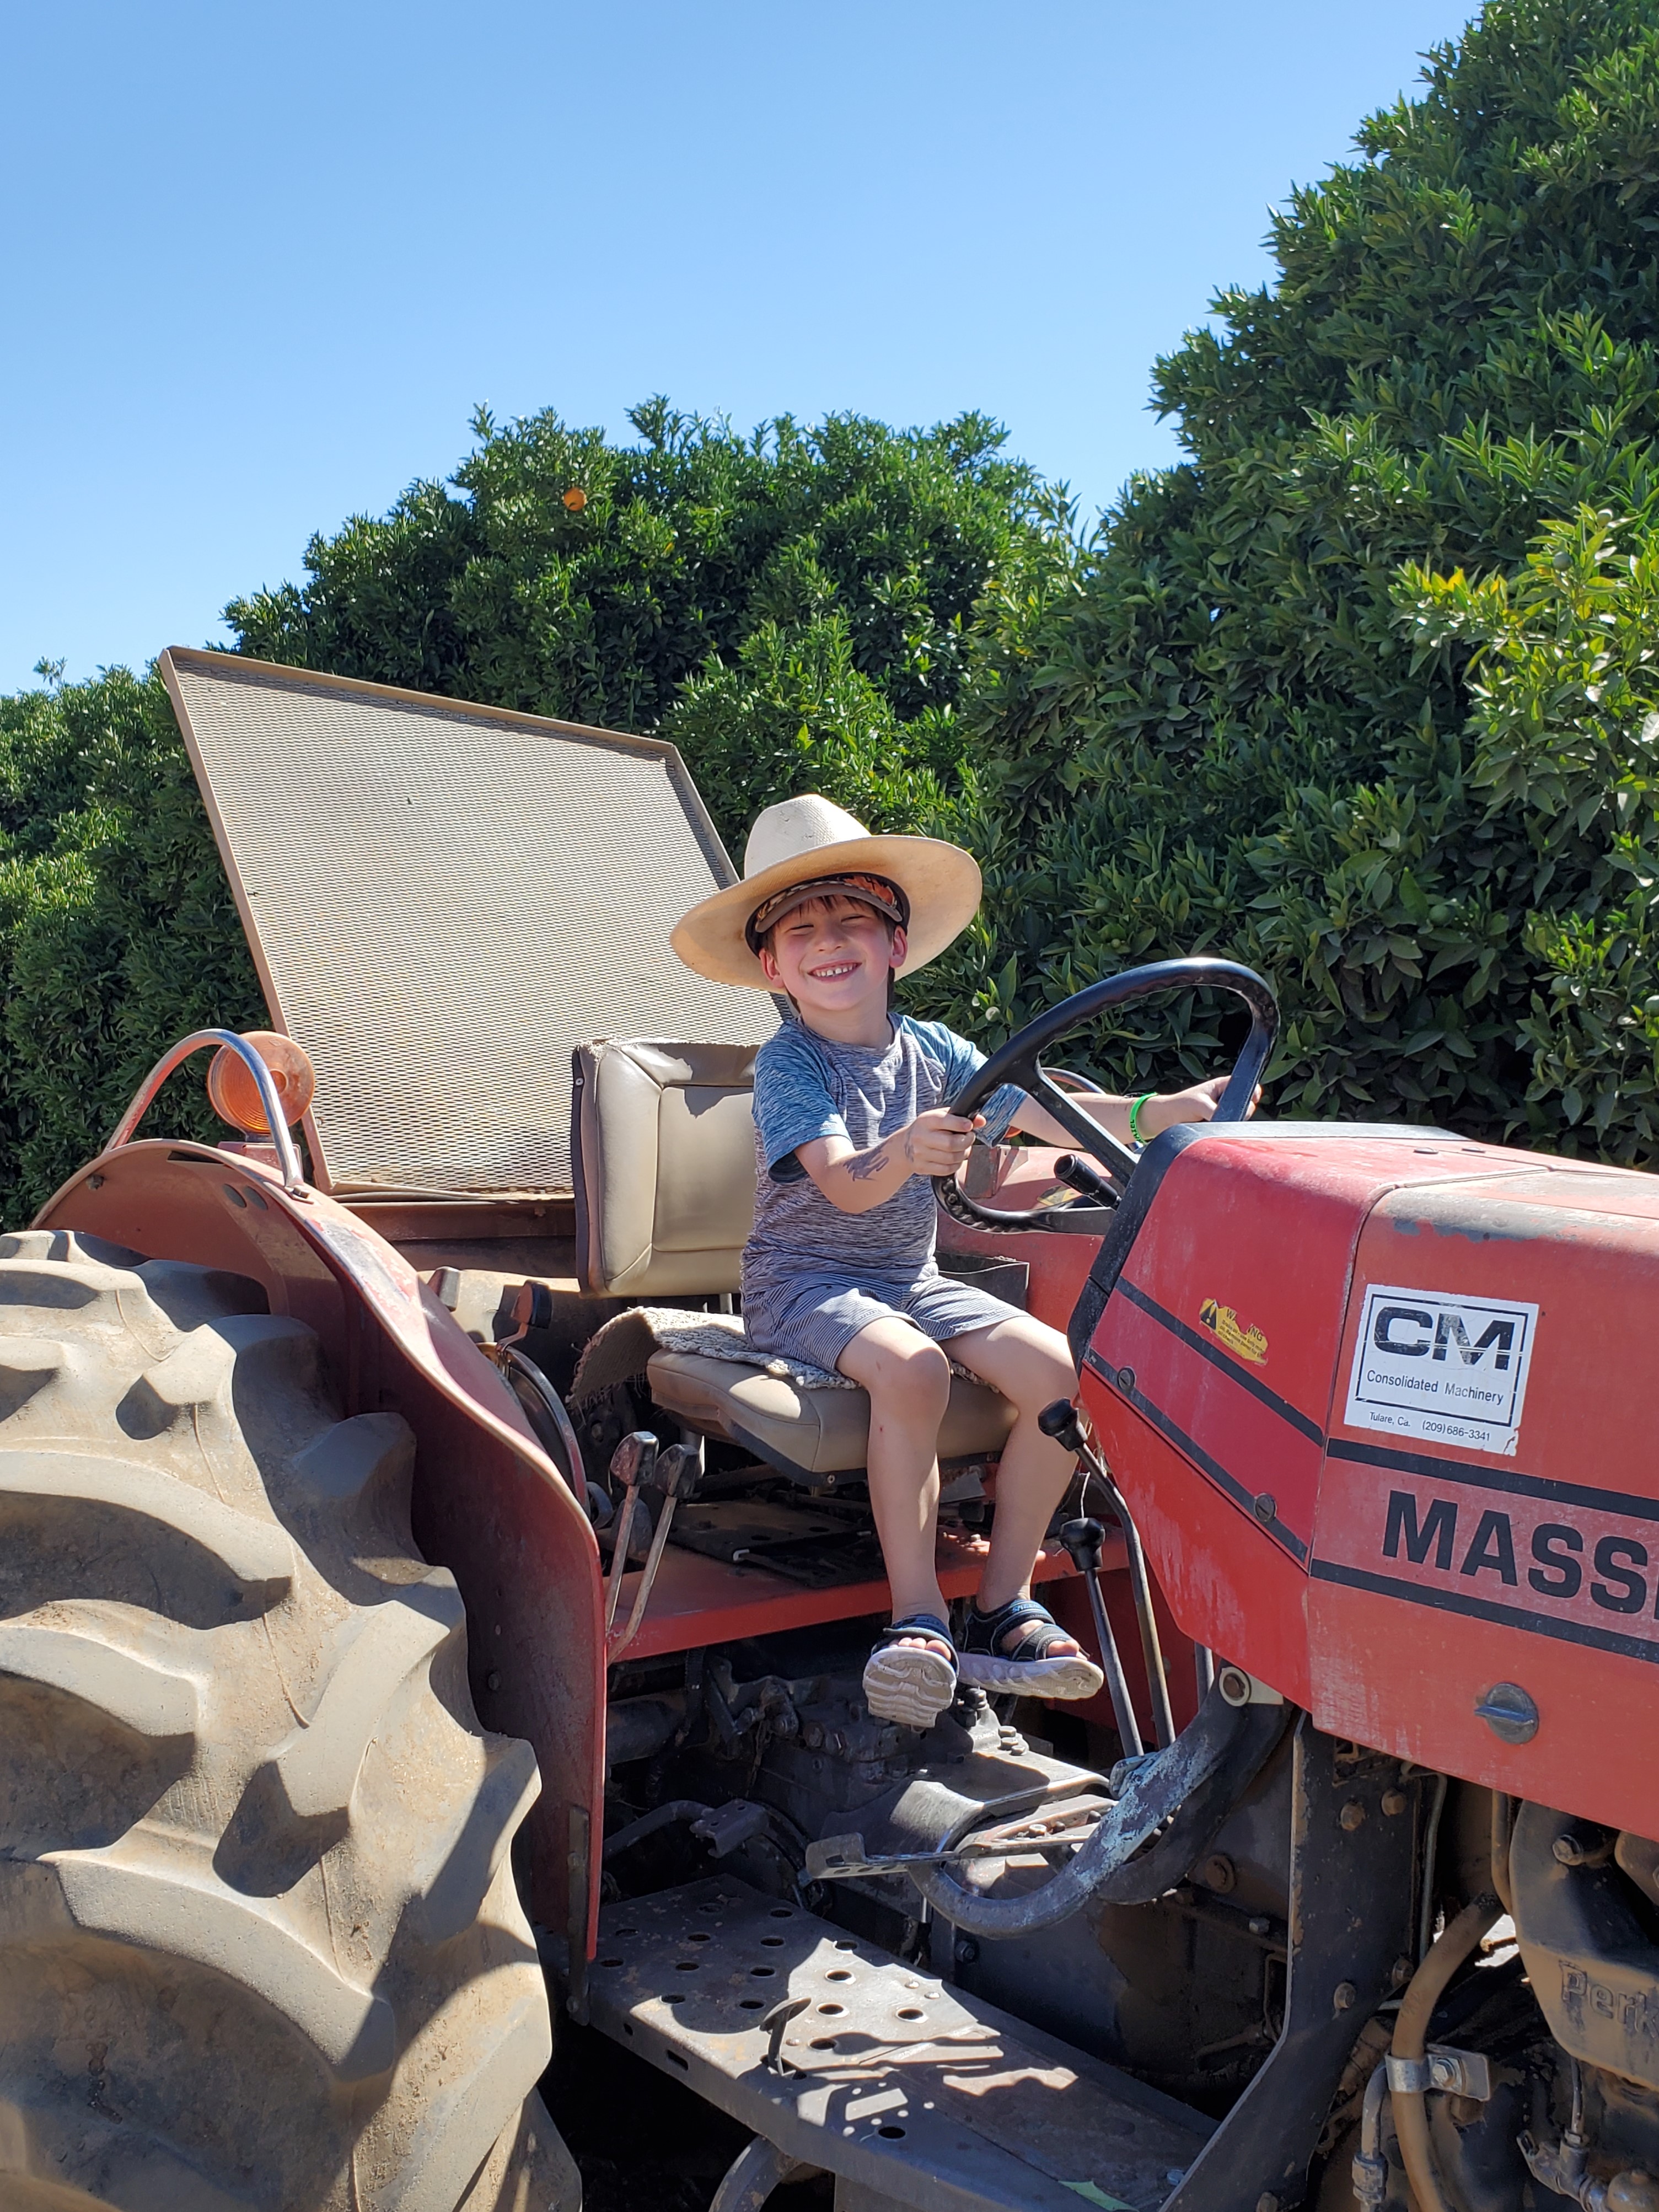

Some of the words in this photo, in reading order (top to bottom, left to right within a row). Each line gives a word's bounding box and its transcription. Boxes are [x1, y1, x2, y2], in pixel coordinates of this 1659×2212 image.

[1226, 1308, 1263, 1342] WING
[1374, 1306, 1515, 1371] CM
[1367, 1370, 1438, 1393] Consolidated
[1445, 1382, 1504, 1405] Machinery
[1370, 1411, 1394, 1425] Tulare,
[1398, 1416, 1411, 1427] Ca.
[1383, 1490, 1659, 1620] MASS
